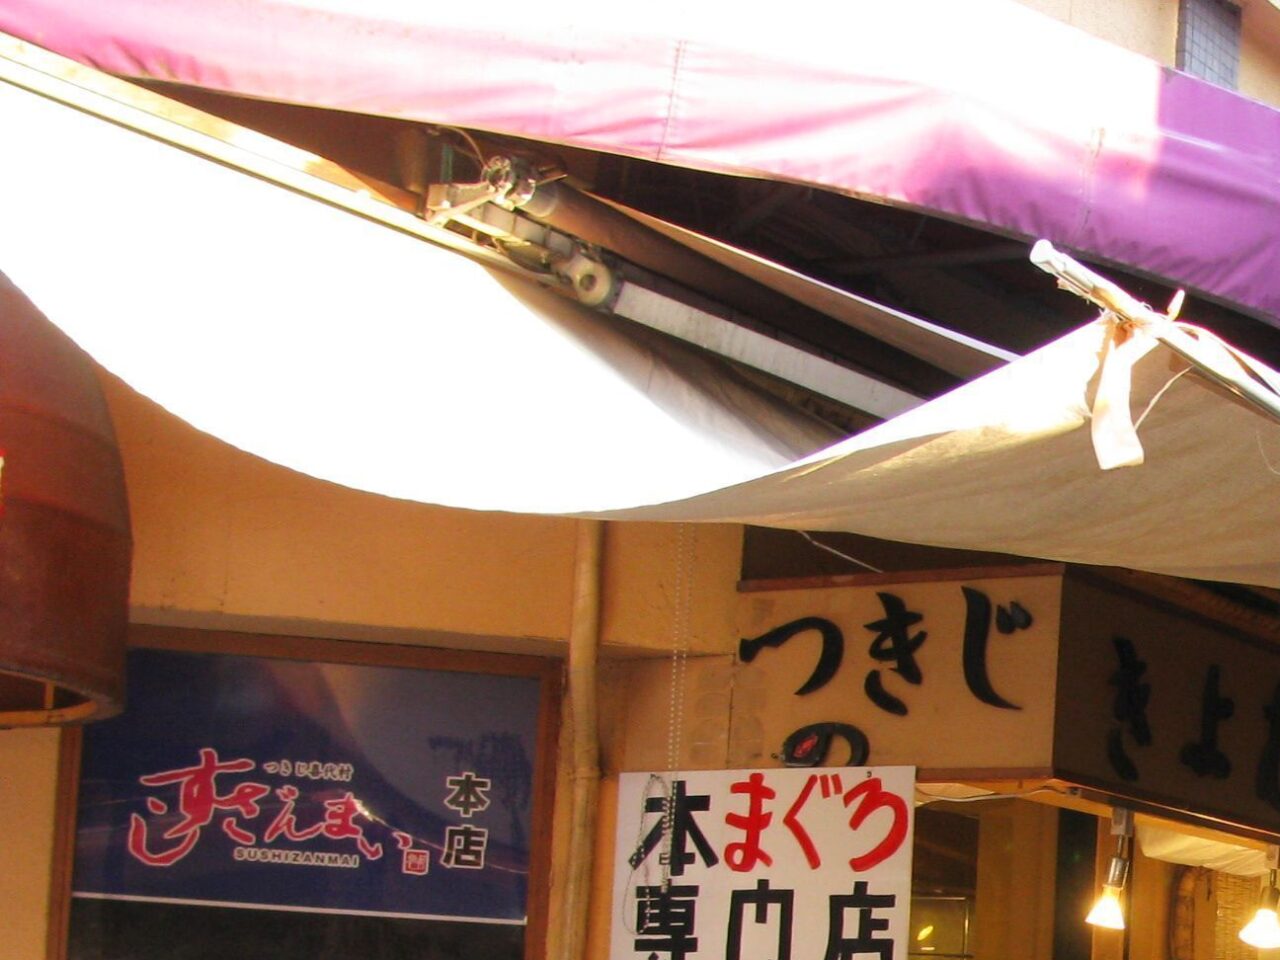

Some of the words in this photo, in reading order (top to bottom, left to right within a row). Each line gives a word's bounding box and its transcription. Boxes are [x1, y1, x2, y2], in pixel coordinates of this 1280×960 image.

[739, 586, 1033, 716] つきじ
[232, 846, 360, 868] SUSHIZANMAI
[439, 771, 491, 870] 本店
[628, 772, 908, 877] 本まぐろ
